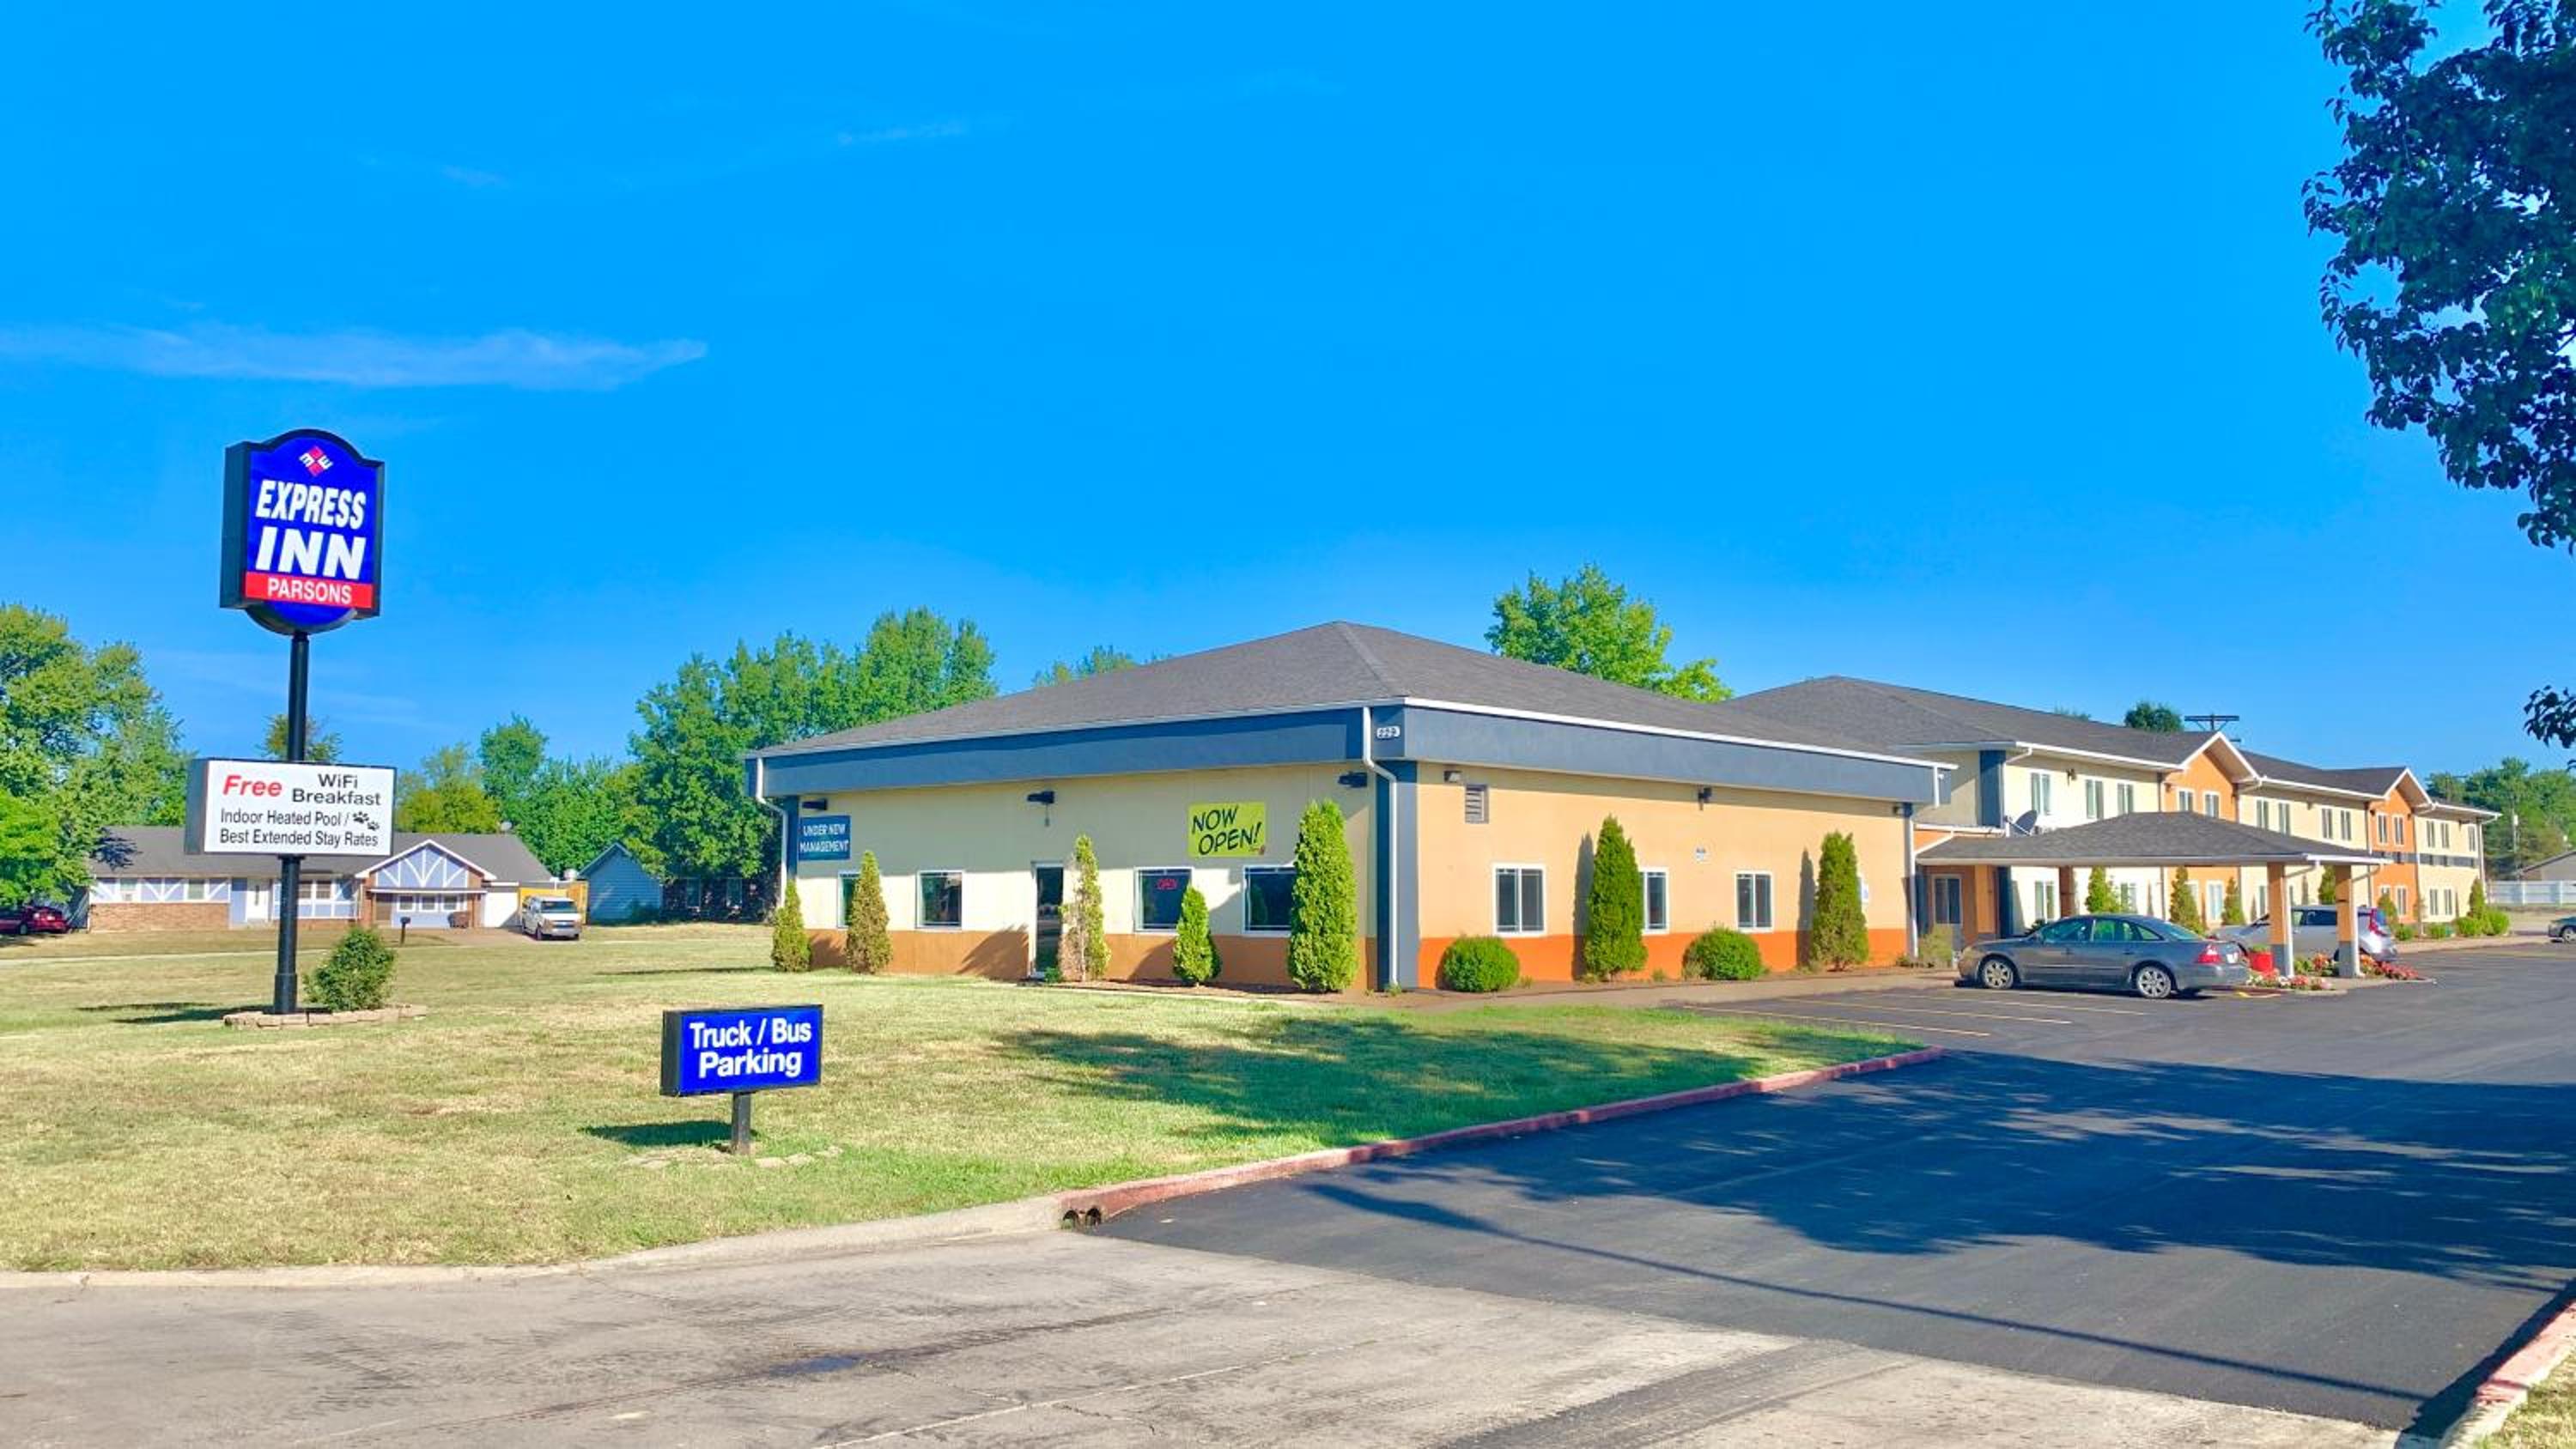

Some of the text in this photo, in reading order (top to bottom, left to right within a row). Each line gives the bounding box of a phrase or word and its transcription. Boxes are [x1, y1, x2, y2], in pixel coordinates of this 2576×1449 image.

[255, 479, 367, 530] EXPRESS
[255, 525, 367, 580] INN
[267, 578, 353, 604] PARSONS
[222, 774, 283, 797] Free
[318, 773, 358, 789] WiFi
[292, 788, 381, 805] Breakfast
[221, 808, 264, 824] Indoor
[267, 809, 311, 825] Heated
[314, 811, 341, 827] Pool
[803, 823, 846, 836] UNDER NEW
[1191, 805, 1239, 834] NOW
[220, 828, 379, 849] Best Extended Stay Rates
[799, 839, 849, 852] MANAGEMENT
[1198, 822, 1262, 856] OPEN!
[689, 1016, 812, 1050] Truck / Bus
[698, 1046, 803, 1079] Parking
